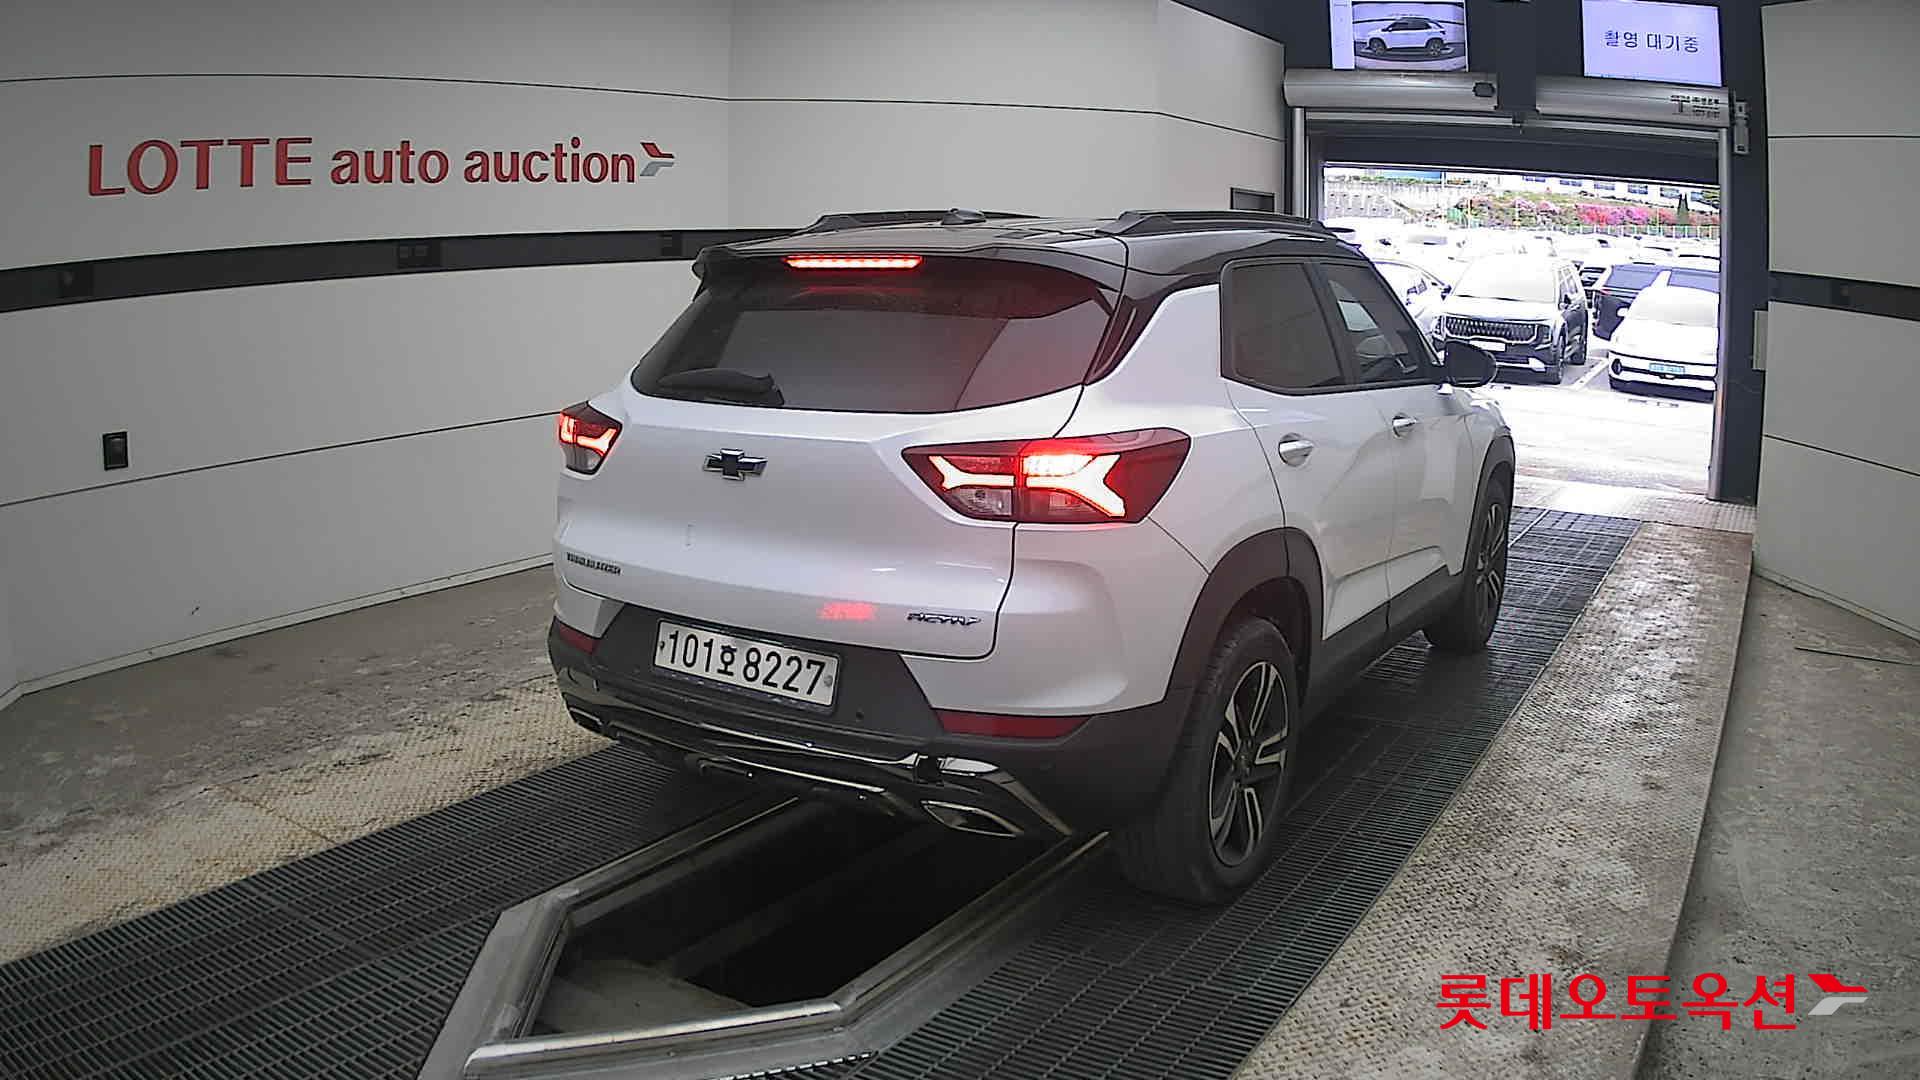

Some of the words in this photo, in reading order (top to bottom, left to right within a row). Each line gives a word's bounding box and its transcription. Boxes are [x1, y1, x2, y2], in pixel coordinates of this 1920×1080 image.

[1646, 32, 1699, 53] 대기중
[89, 137, 313, 196] LOTTE
[330, 140, 449, 185] auto
[463, 136, 636, 184] auction
